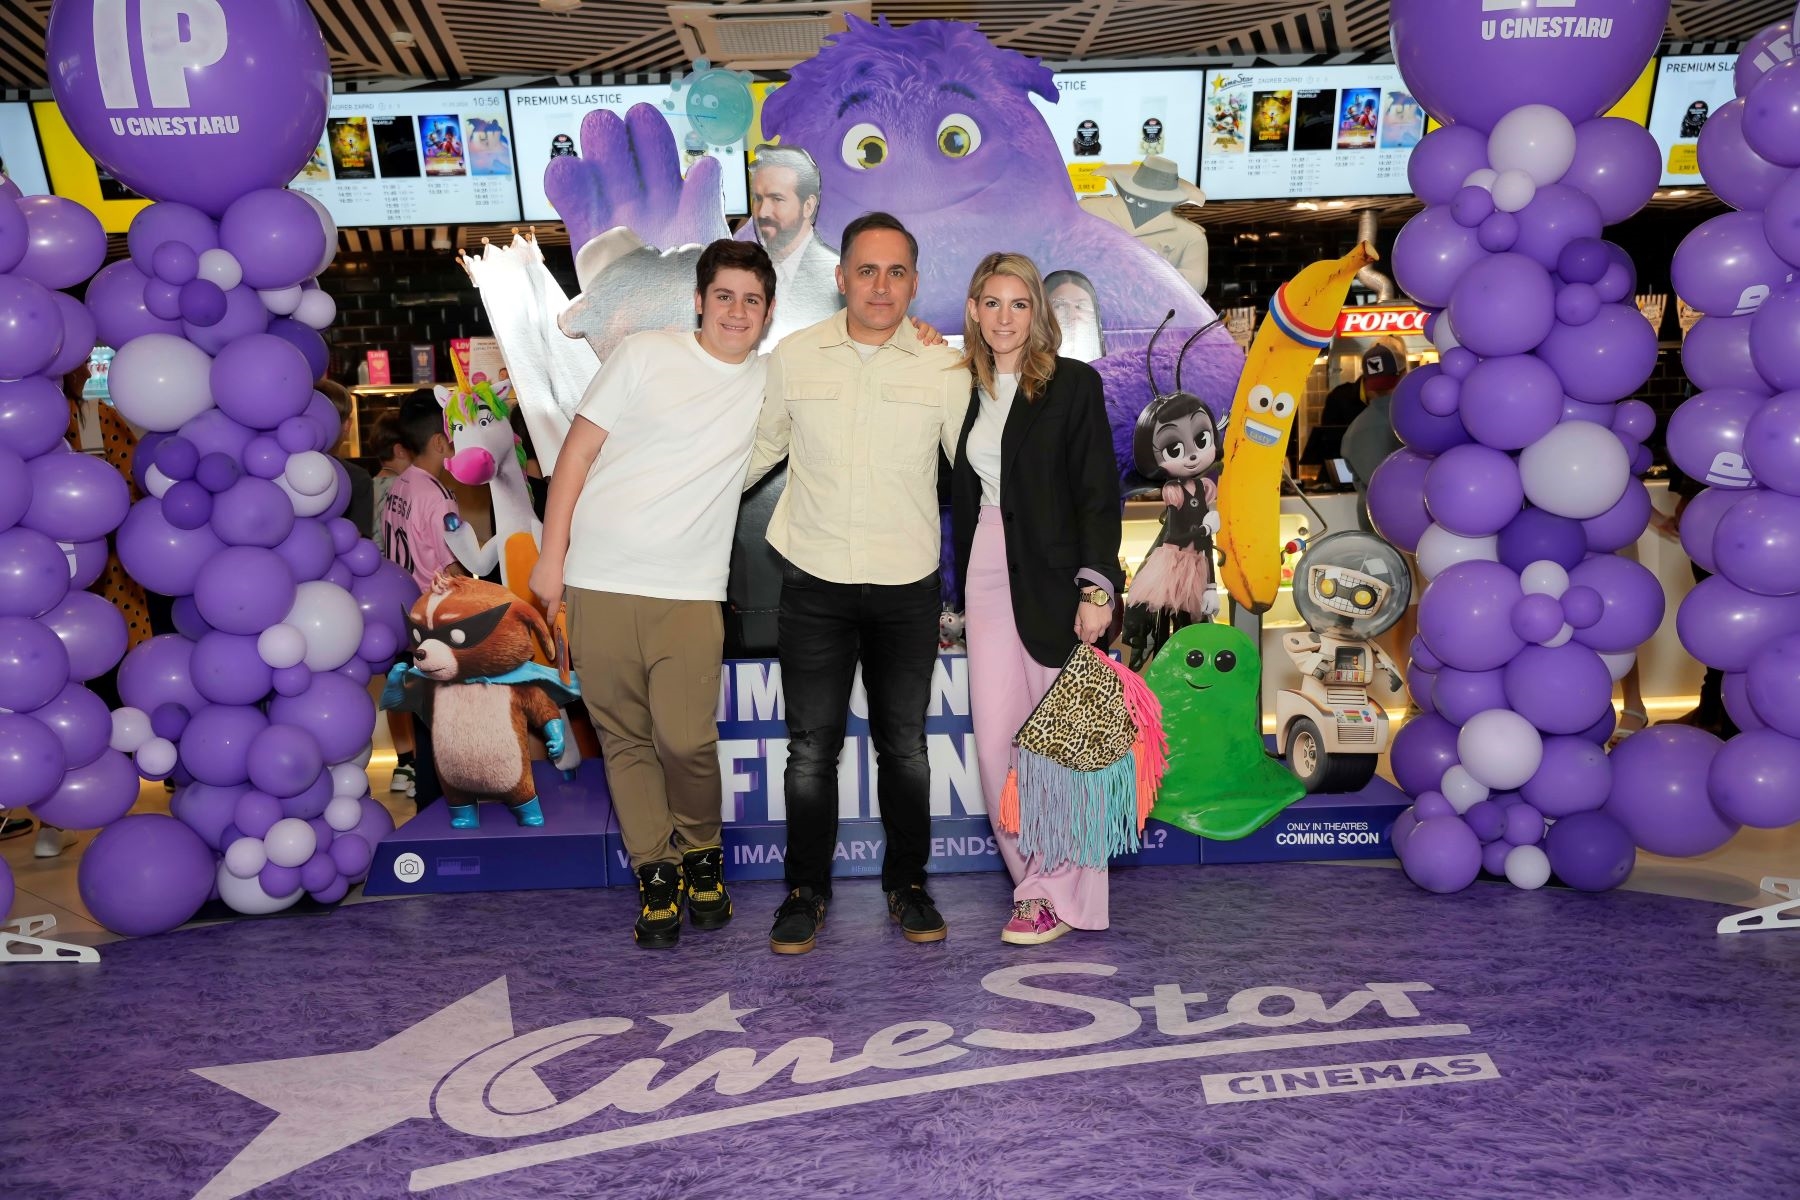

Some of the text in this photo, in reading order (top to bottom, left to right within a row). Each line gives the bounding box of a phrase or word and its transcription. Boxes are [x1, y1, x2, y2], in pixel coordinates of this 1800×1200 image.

[1481, 16, 1613, 40] U CINESTARU
[92, 0, 229, 109] IP
[1666, 61, 1716, 73] PREMIUM
[1056, 80, 1087, 91] STICE
[473, 96, 500, 106] 10:56
[516, 94, 623, 106] PREMIUM SLASTICE
[109, 115, 240, 136] U CINESTARU
[1343, 310, 1432, 331] POPCO
[1286, 823, 1310, 831] ONLY
[1322, 822, 1368, 831] THEATRES
[1276, 832, 1379, 845] COMING SOON
[434, 961, 1435, 1138] CineStar
[1227, 1057, 1483, 1096] CINEMAS
